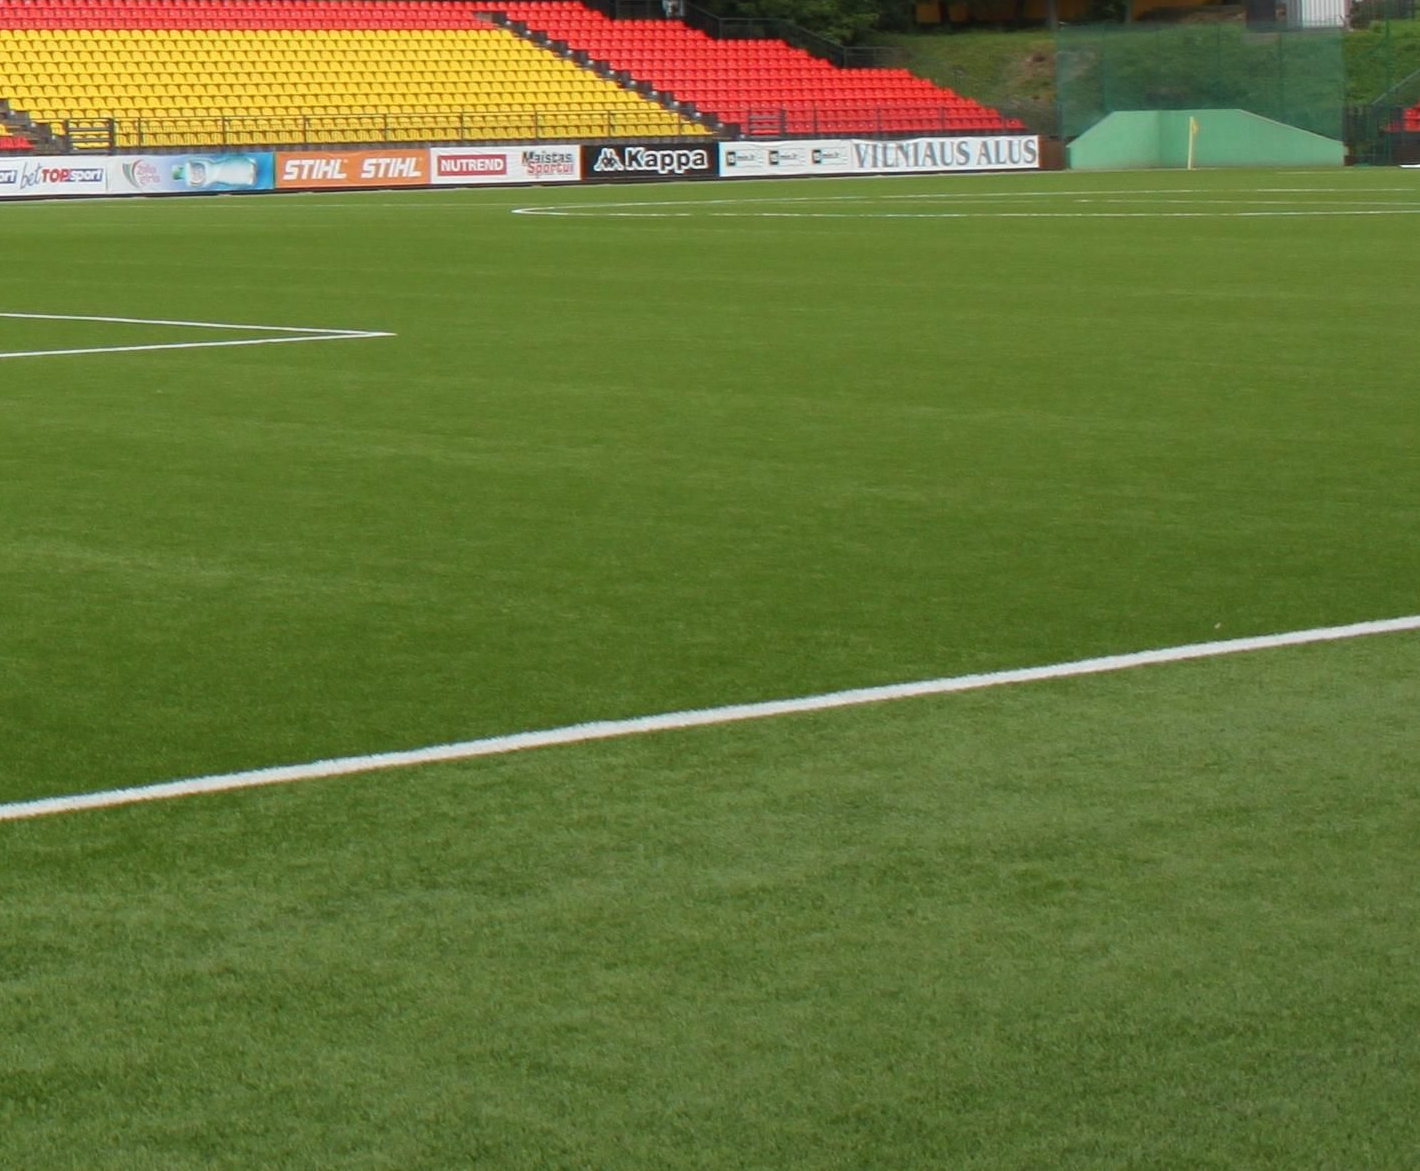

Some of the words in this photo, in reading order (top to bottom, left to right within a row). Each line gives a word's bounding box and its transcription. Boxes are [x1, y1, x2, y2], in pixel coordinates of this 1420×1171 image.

[440, 157, 504, 173] NUTREND
[626, 146, 708, 173] Kappa
[853, 140, 970, 169] VILNIAUS
[977, 138, 1037, 165] ALUS
[283, 159, 347, 180] STIHL
[361, 157, 422, 178] STIHL
